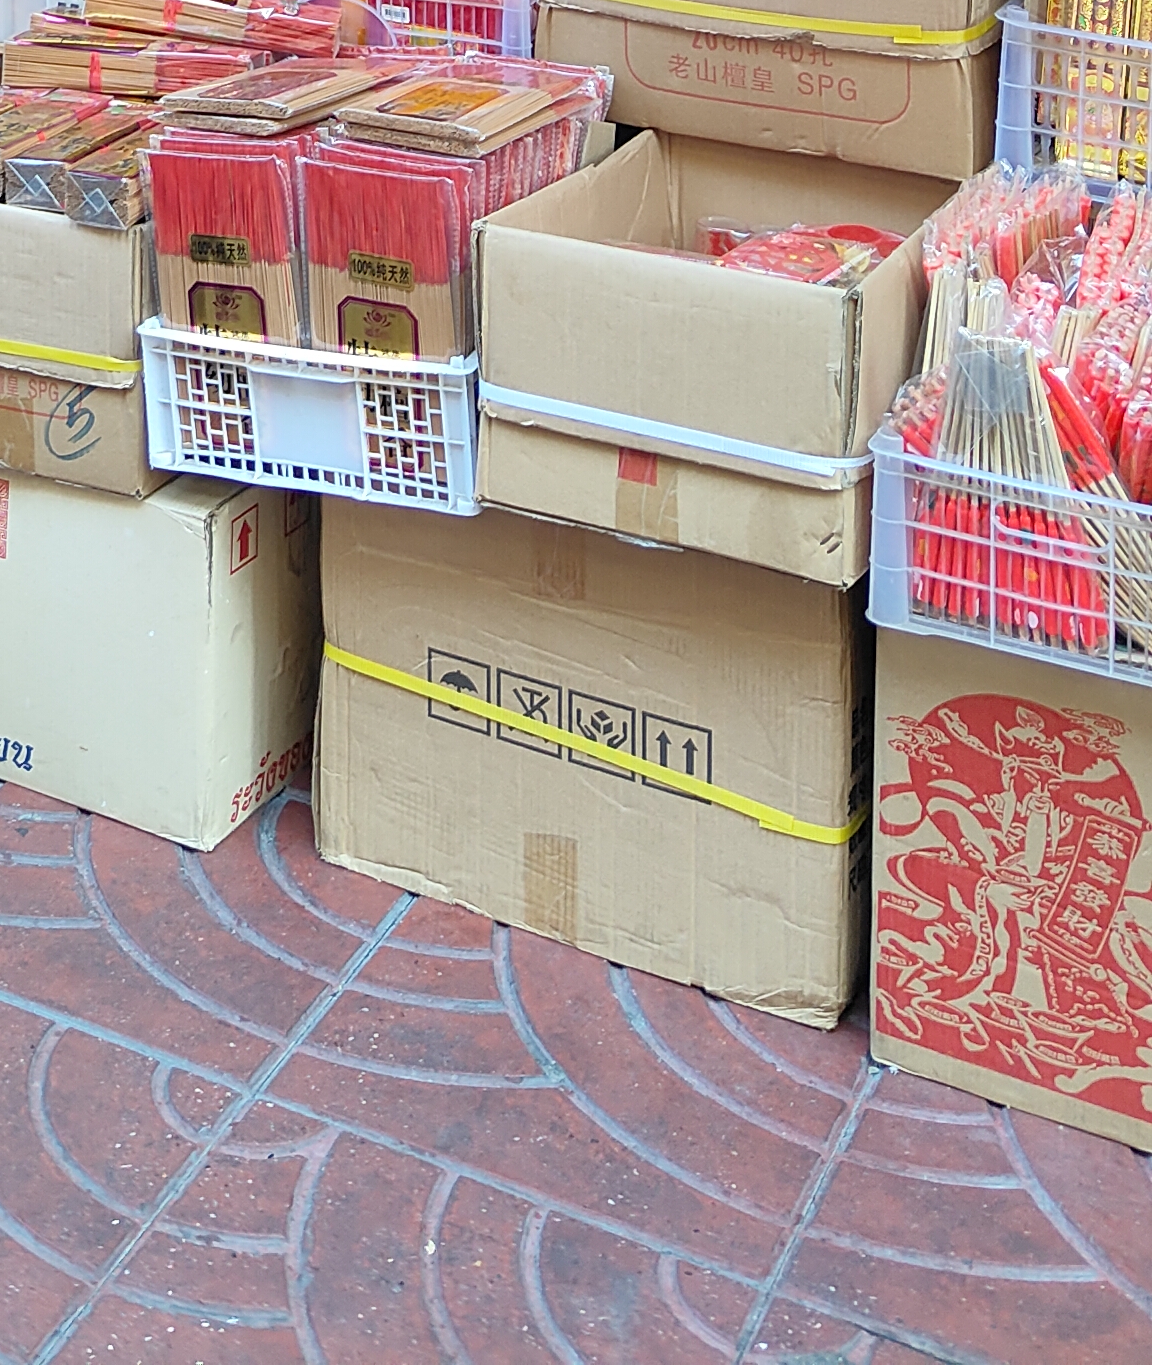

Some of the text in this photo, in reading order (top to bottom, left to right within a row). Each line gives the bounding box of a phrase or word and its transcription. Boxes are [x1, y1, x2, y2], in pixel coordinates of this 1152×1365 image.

[668, 53, 859, 102] 老山檀皇 SPG
[28, 378, 60, 403] SPG
